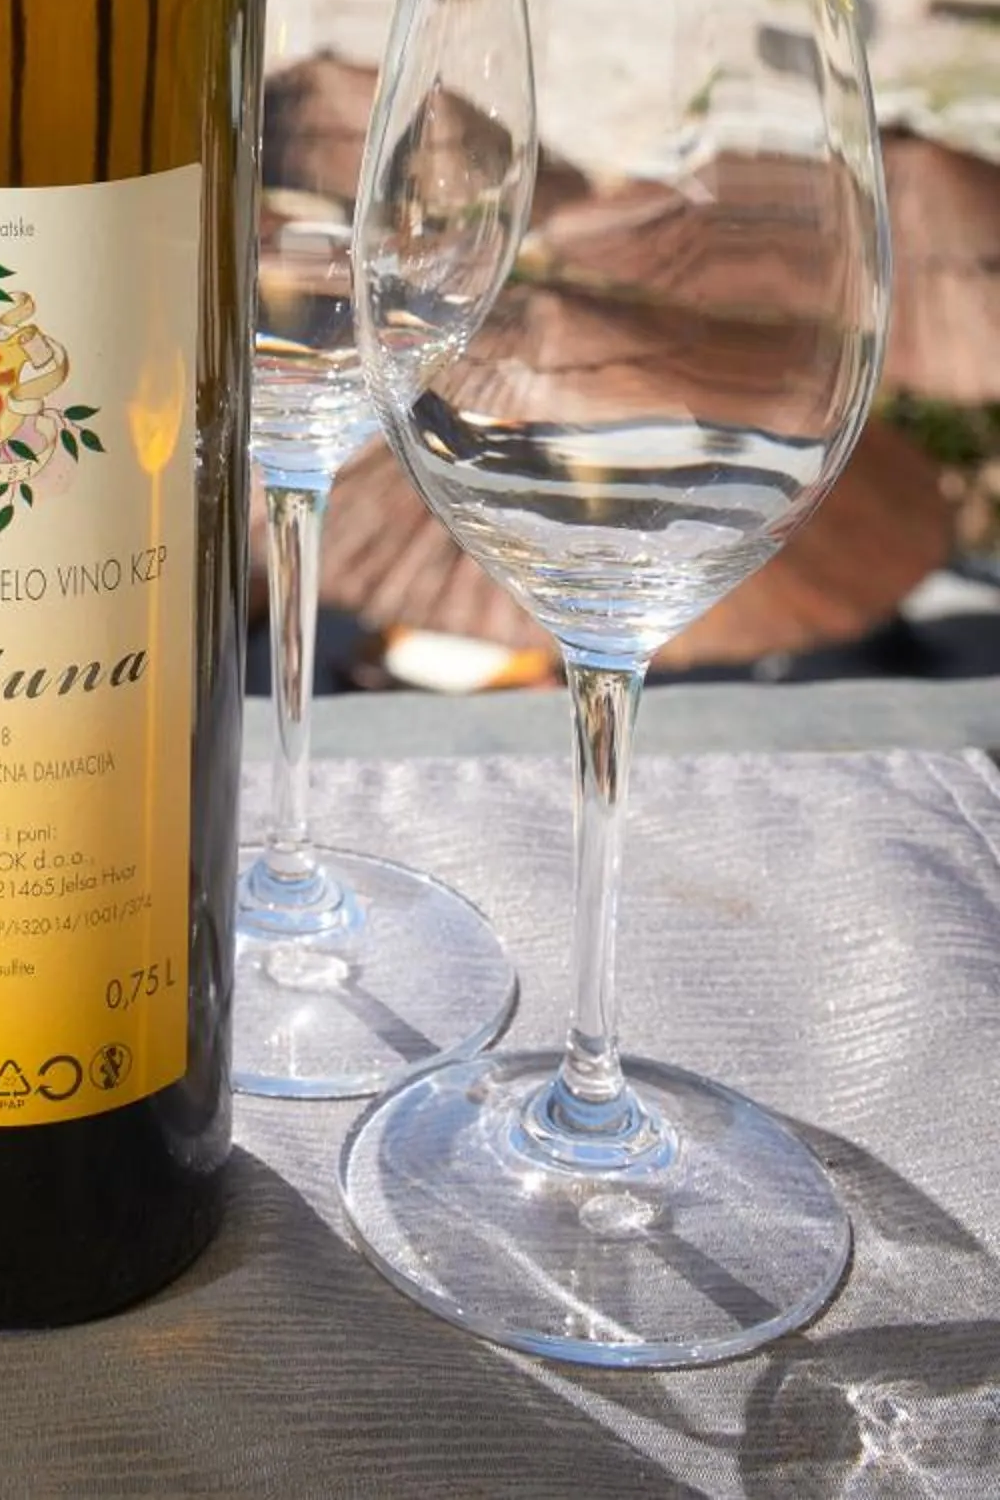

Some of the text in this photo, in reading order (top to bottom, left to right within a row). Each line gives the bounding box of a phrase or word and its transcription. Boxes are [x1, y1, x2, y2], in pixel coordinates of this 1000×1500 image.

[57, 558, 121, 596] VINO
[130, 545, 168, 586] KZP
[33, 751, 116, 782] DALMACIJA
[60, 872, 97, 897] Jelsa
[102, 864, 136, 884] Hvar
[106, 958, 177, 1011] 0,75 L
